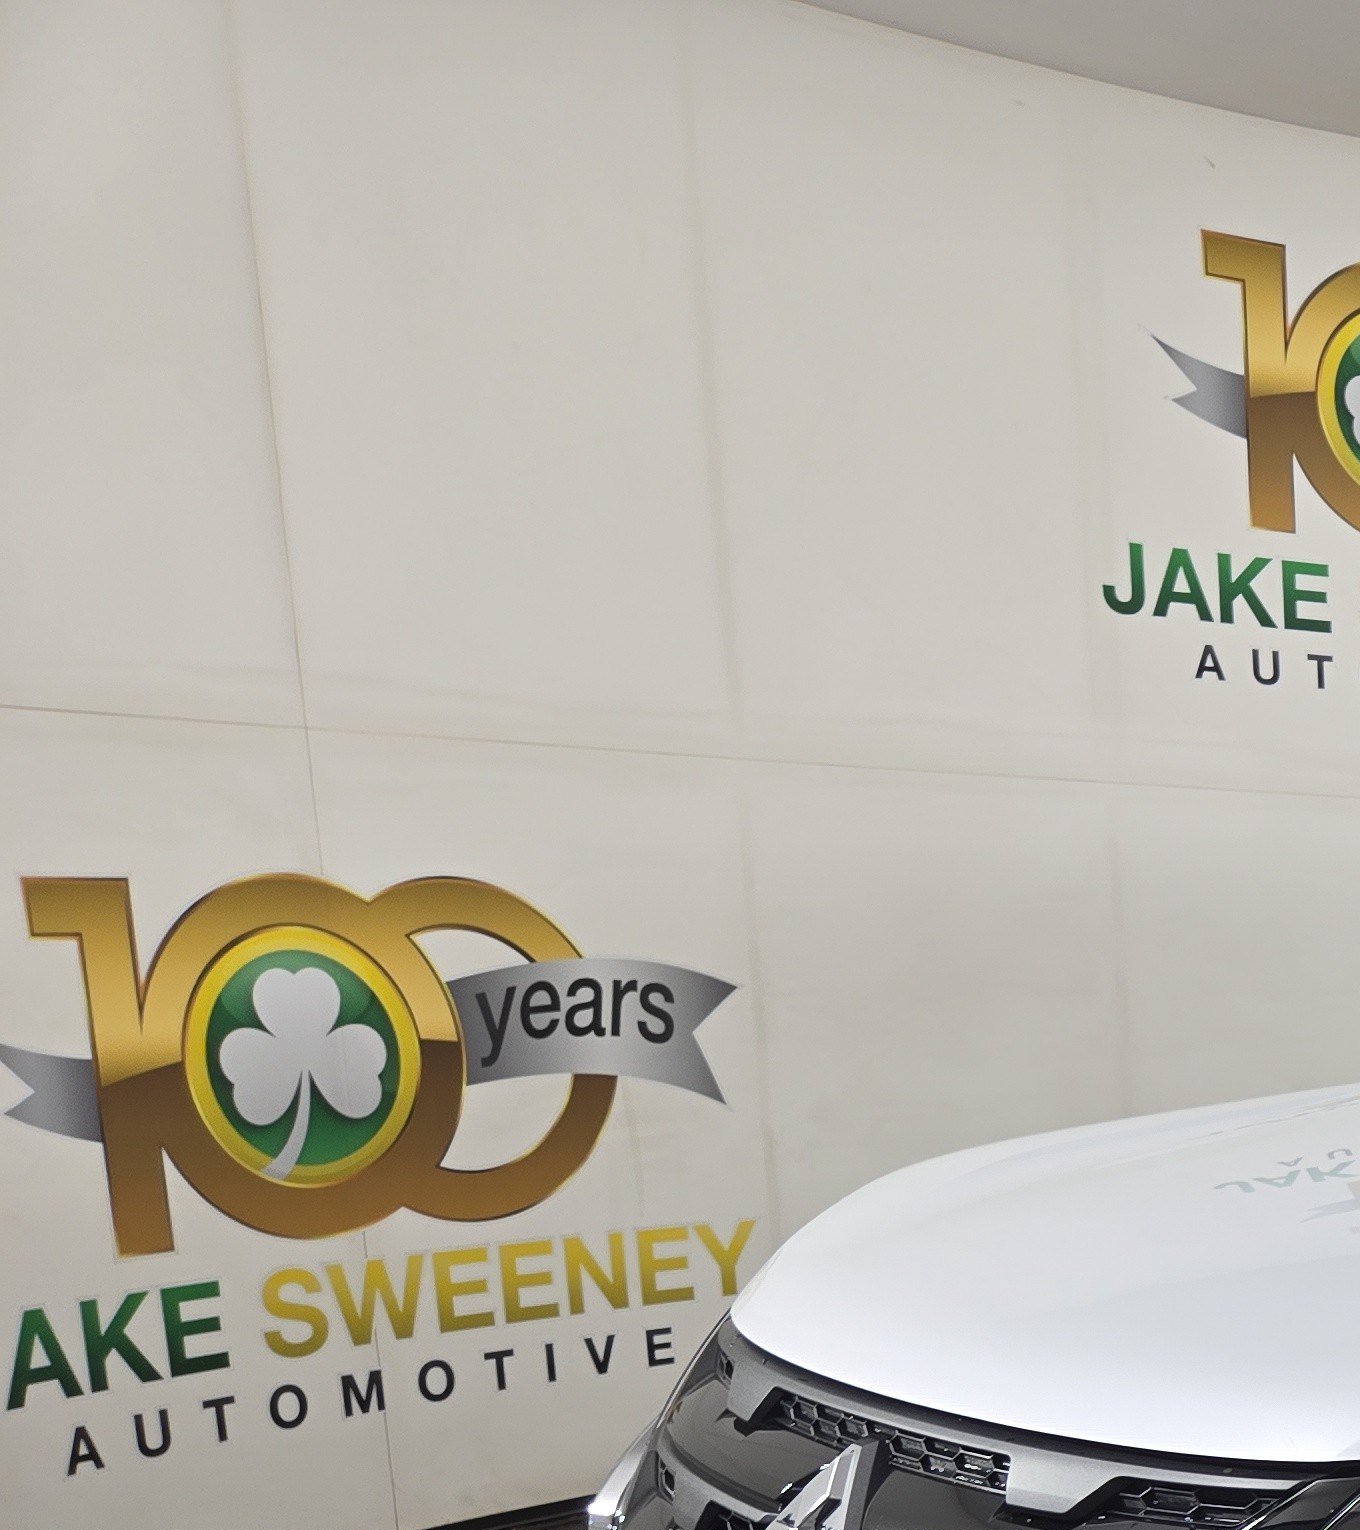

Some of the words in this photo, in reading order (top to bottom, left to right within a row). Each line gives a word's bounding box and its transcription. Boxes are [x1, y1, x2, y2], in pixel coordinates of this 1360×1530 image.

[1102, 542, 1332, 634] JAKE
[20, 873, 618, 1258] 100
[476, 978, 675, 1068] years
[5, 1280, 231, 1412] AKE
[261, 1220, 756, 1359] SWEENEY
[66, 1327, 675, 1477] AUTOMOTIVE
